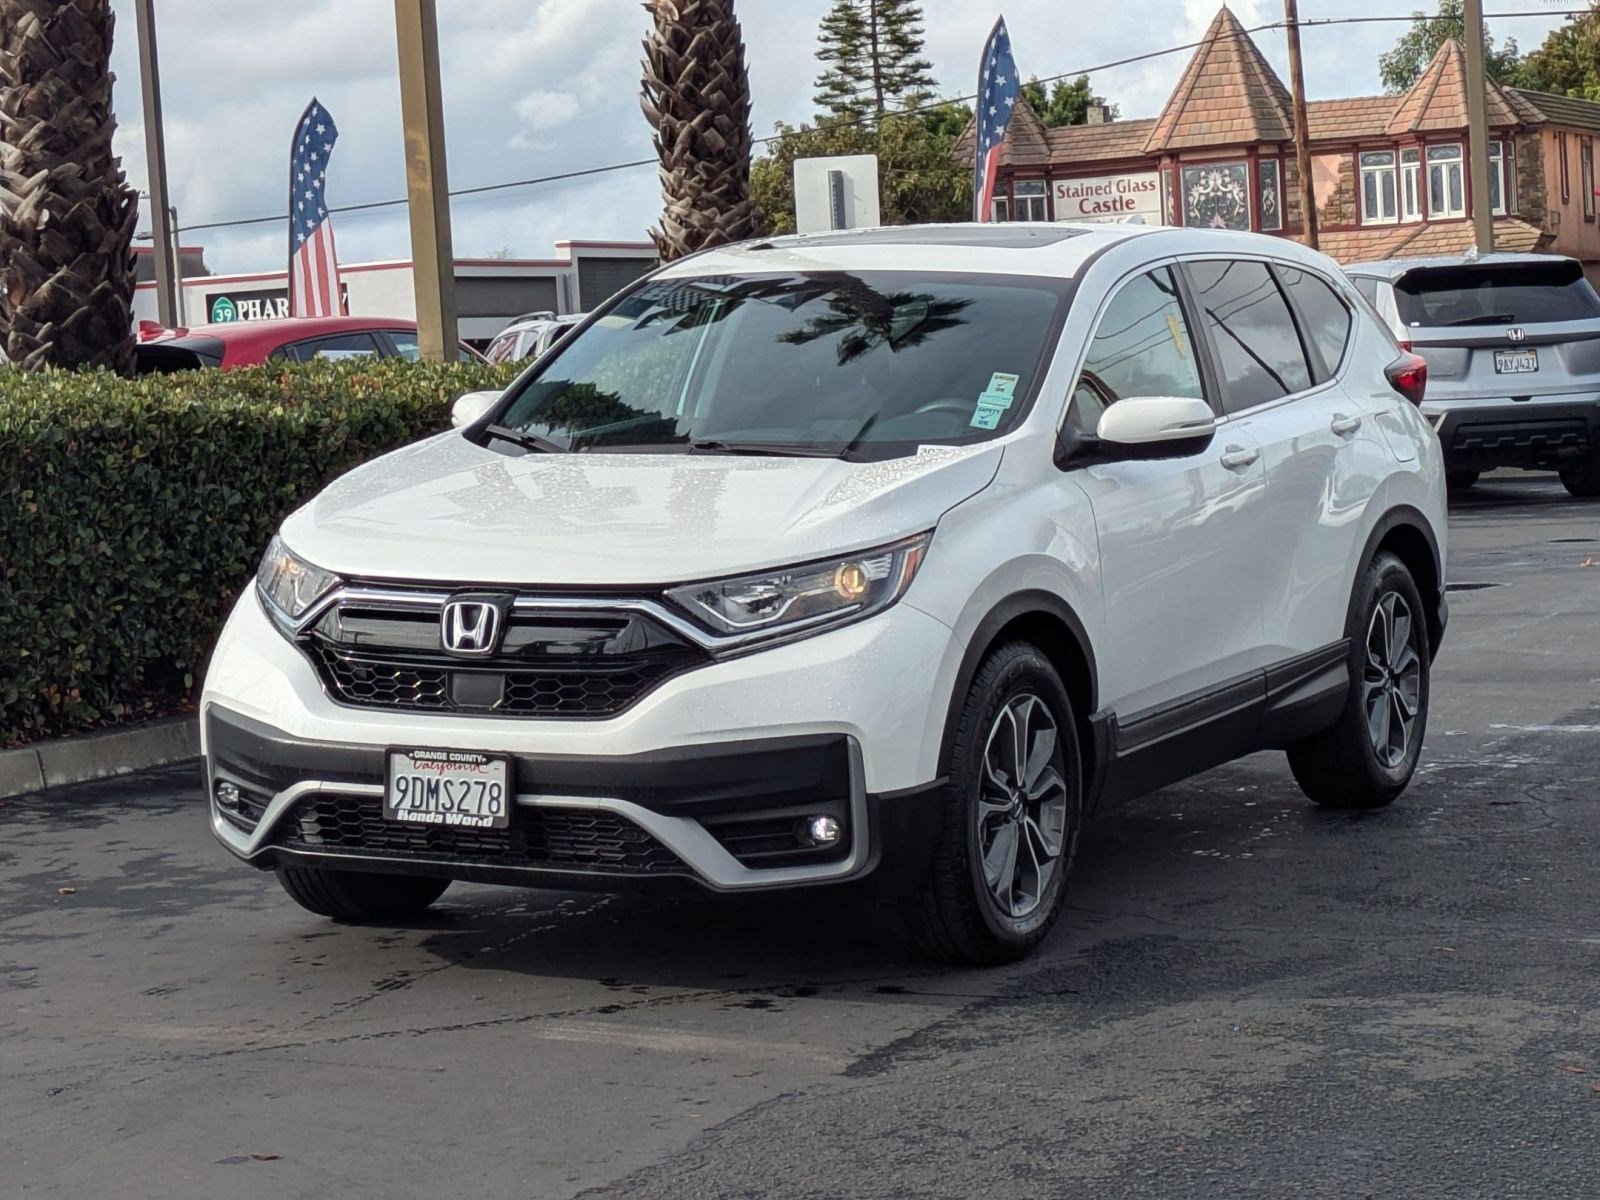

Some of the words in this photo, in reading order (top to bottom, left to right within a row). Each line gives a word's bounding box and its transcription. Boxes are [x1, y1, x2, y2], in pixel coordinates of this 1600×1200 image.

[1057, 181, 1112, 199] Stained
[1116, 179, 1156, 194] Glass
[1079, 195, 1136, 214] Castle
[216, 309, 232, 322] 39
[414, 750, 448, 760] ORANGE
[449, 753, 483, 763] COUNTY
[394, 775, 502, 815] 9DMS278
[396, 810, 443, 824] Honda
